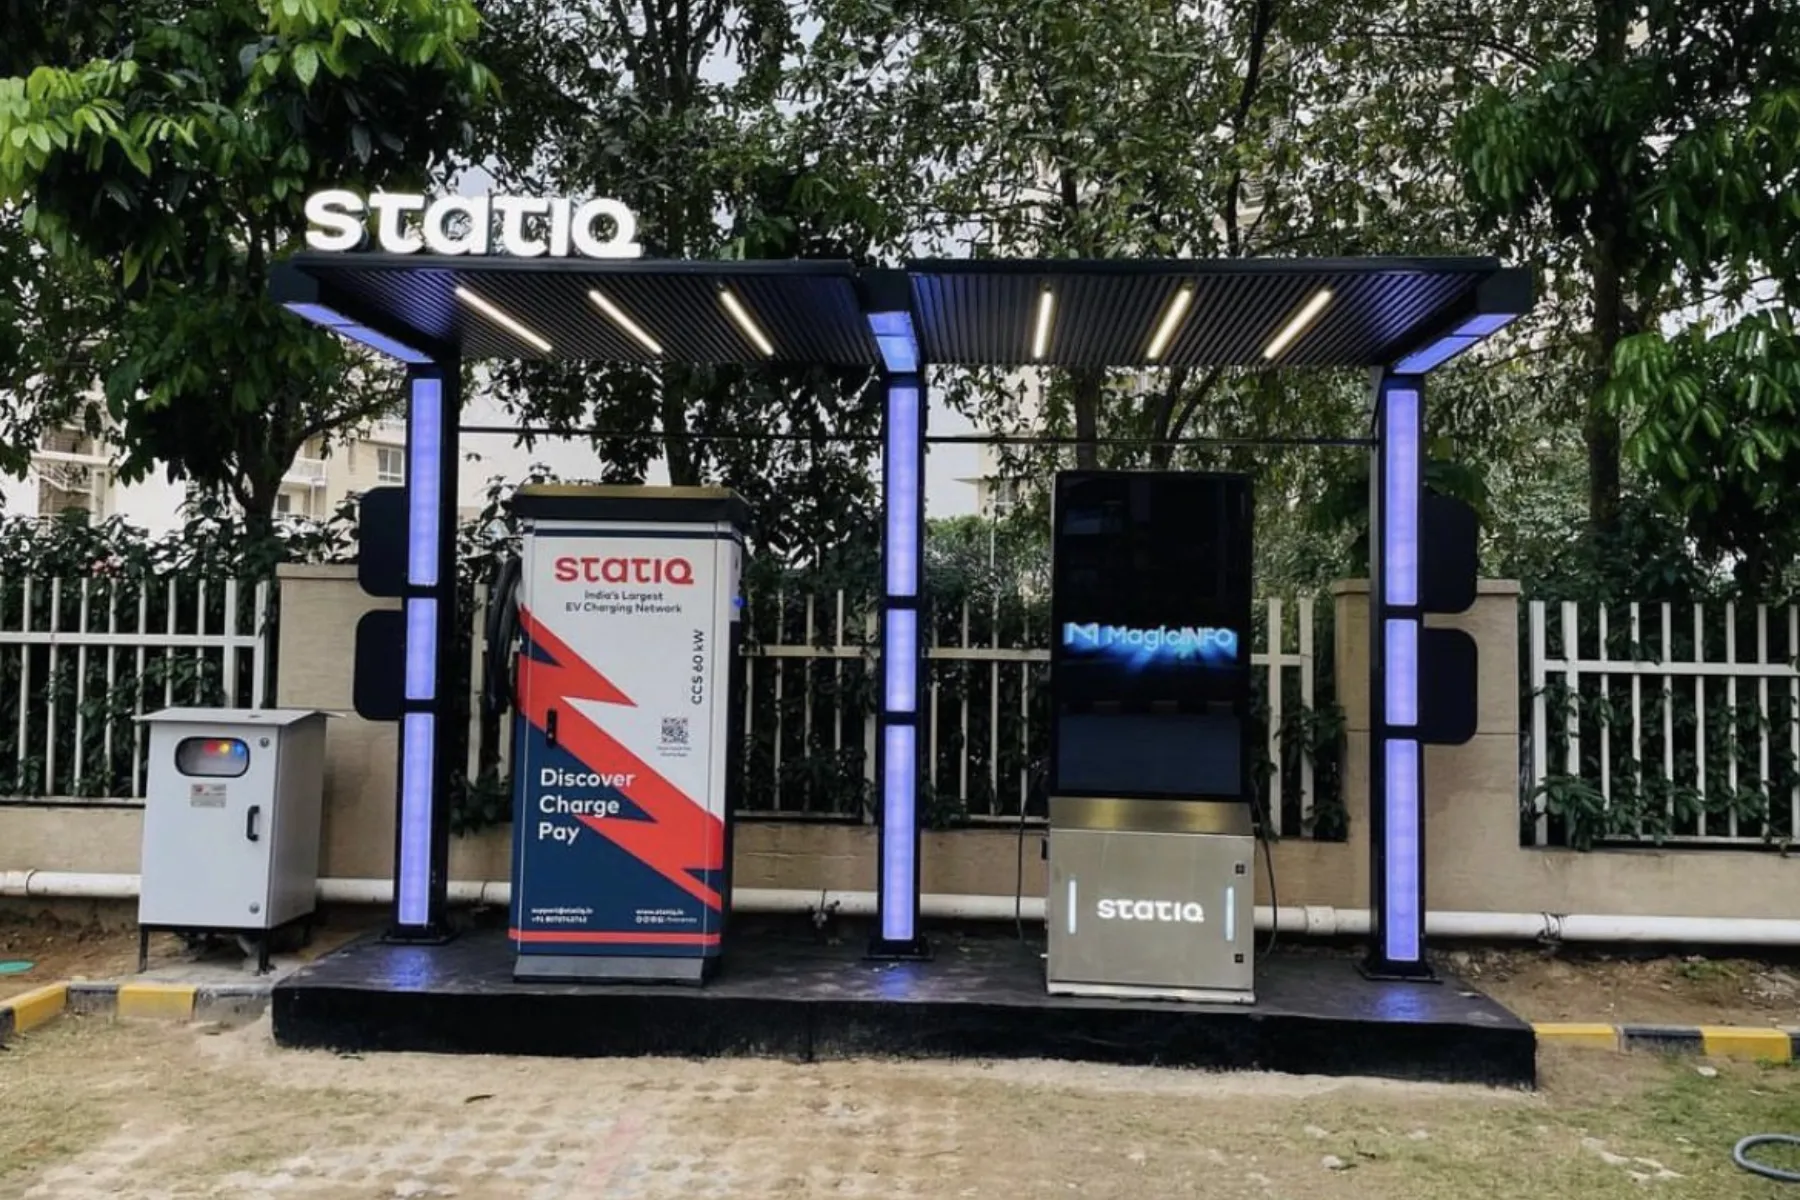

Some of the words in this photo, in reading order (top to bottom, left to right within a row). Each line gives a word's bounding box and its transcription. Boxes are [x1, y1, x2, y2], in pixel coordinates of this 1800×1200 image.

[584, 590, 619, 600] India's
[622, 591, 663, 602] Largest
[565, 602, 580, 612] EV
[584, 602, 633, 614] Charging
[636, 604, 682, 613] Network
[692, 629, 704, 651] kW
[1106, 625, 1234, 651] MagicINFO
[692, 655, 704, 673] 60
[691, 675, 703, 705] CCS
[541, 768, 635, 787] Discover
[539, 795, 620, 817] Charge
[538, 822, 580, 845] Pay
